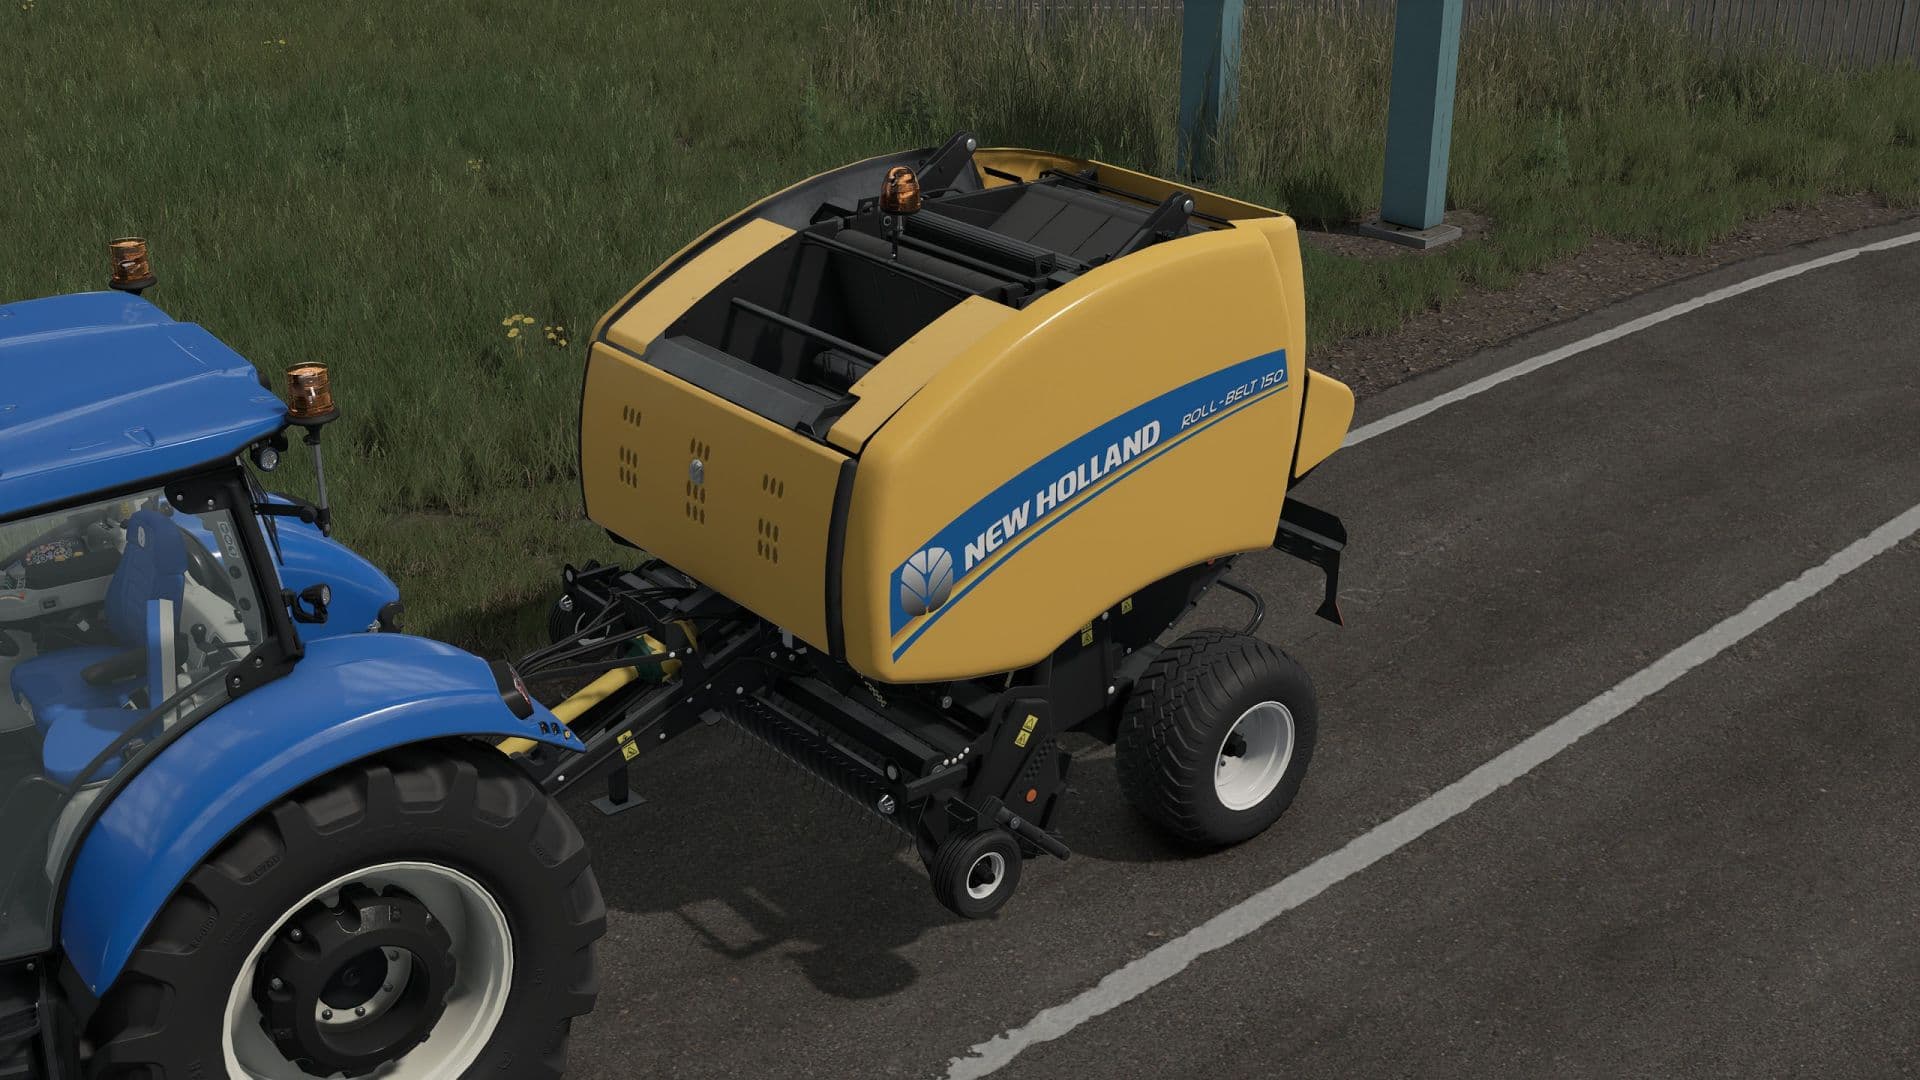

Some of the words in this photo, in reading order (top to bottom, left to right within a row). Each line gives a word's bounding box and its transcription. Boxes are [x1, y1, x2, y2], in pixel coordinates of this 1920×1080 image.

[1181, 379, 1258, 430] ROLL-BELT
[1260, 369, 1284, 389] 150
[964, 500, 1030, 571] NEW
[1036, 420, 1161, 518] HOLLAND
